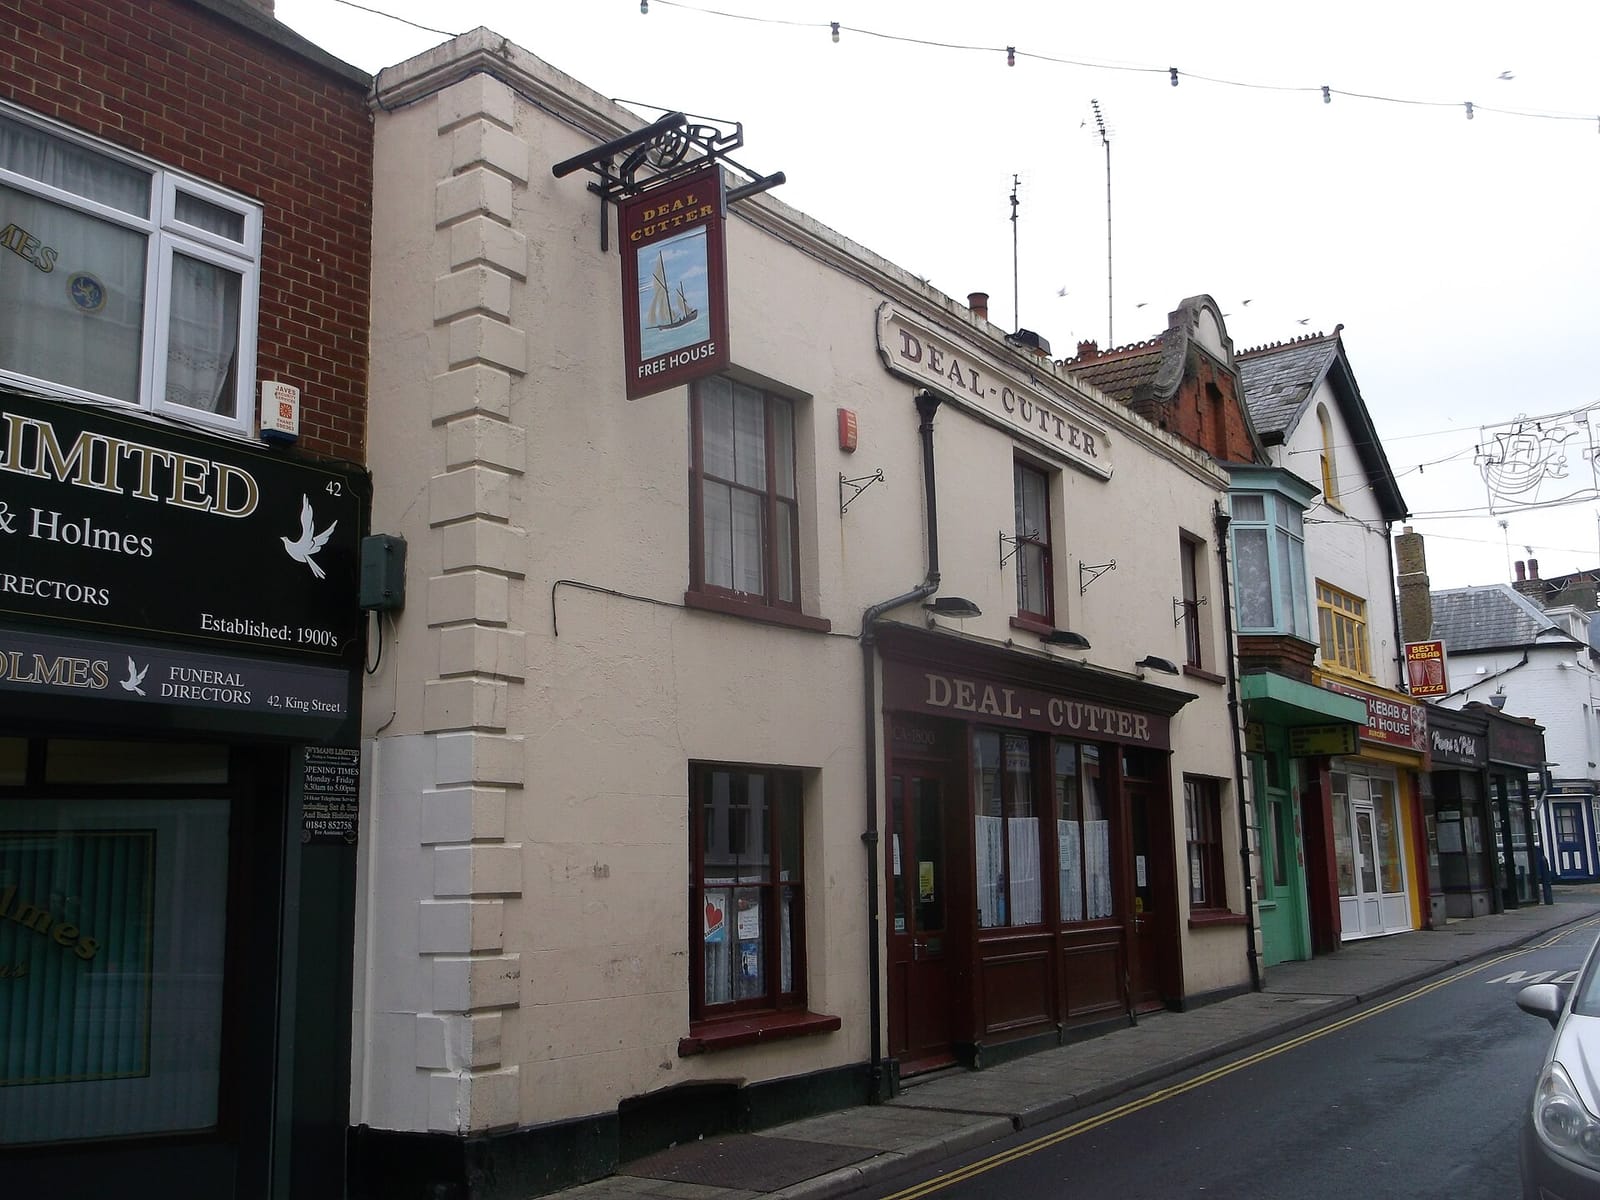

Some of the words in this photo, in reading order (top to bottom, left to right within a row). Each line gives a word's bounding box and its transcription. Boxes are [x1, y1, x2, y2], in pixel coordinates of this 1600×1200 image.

[643, 192, 698, 222] DEAL
[630, 205, 713, 241] CUTTER
[638, 360, 666, 378] FREE
[669, 342, 715, 369] HOUSE
[0, 411, 260, 519] IMITED
[325, 480, 342, 497] 42
[29, 507, 153, 558] Holmes
[200, 613, 292, 641] Established:
[297, 626, 338, 648] 1900's
[1408, 650, 1440, 660] KEBAB
[1411, 644, 1436, 653] BEST
[170, 666, 245, 688] FUNERAL
[161, 683, 251, 705] DIRECTORS
[1411, 684, 1444, 694] PIZZA
[267, 694, 283, 709] 42,
[285, 696, 309, 712] King
[311, 699, 341, 713] Street
[925, 673, 1022, 719] DEAL
[1048, 698, 1150, 742] CUTTER
[1369, 698, 1400, 719] KEBAB
[1401, 707, 1409, 721] &
[1378, 718, 1410, 736] HOUSE
[304, 766, 336, 775] OPENING
[338, 767, 360, 775] TIMES
[306, 774, 330, 784] Monday
[336, 775, 354, 785] Friday
[306, 820, 327, 829] 01843
